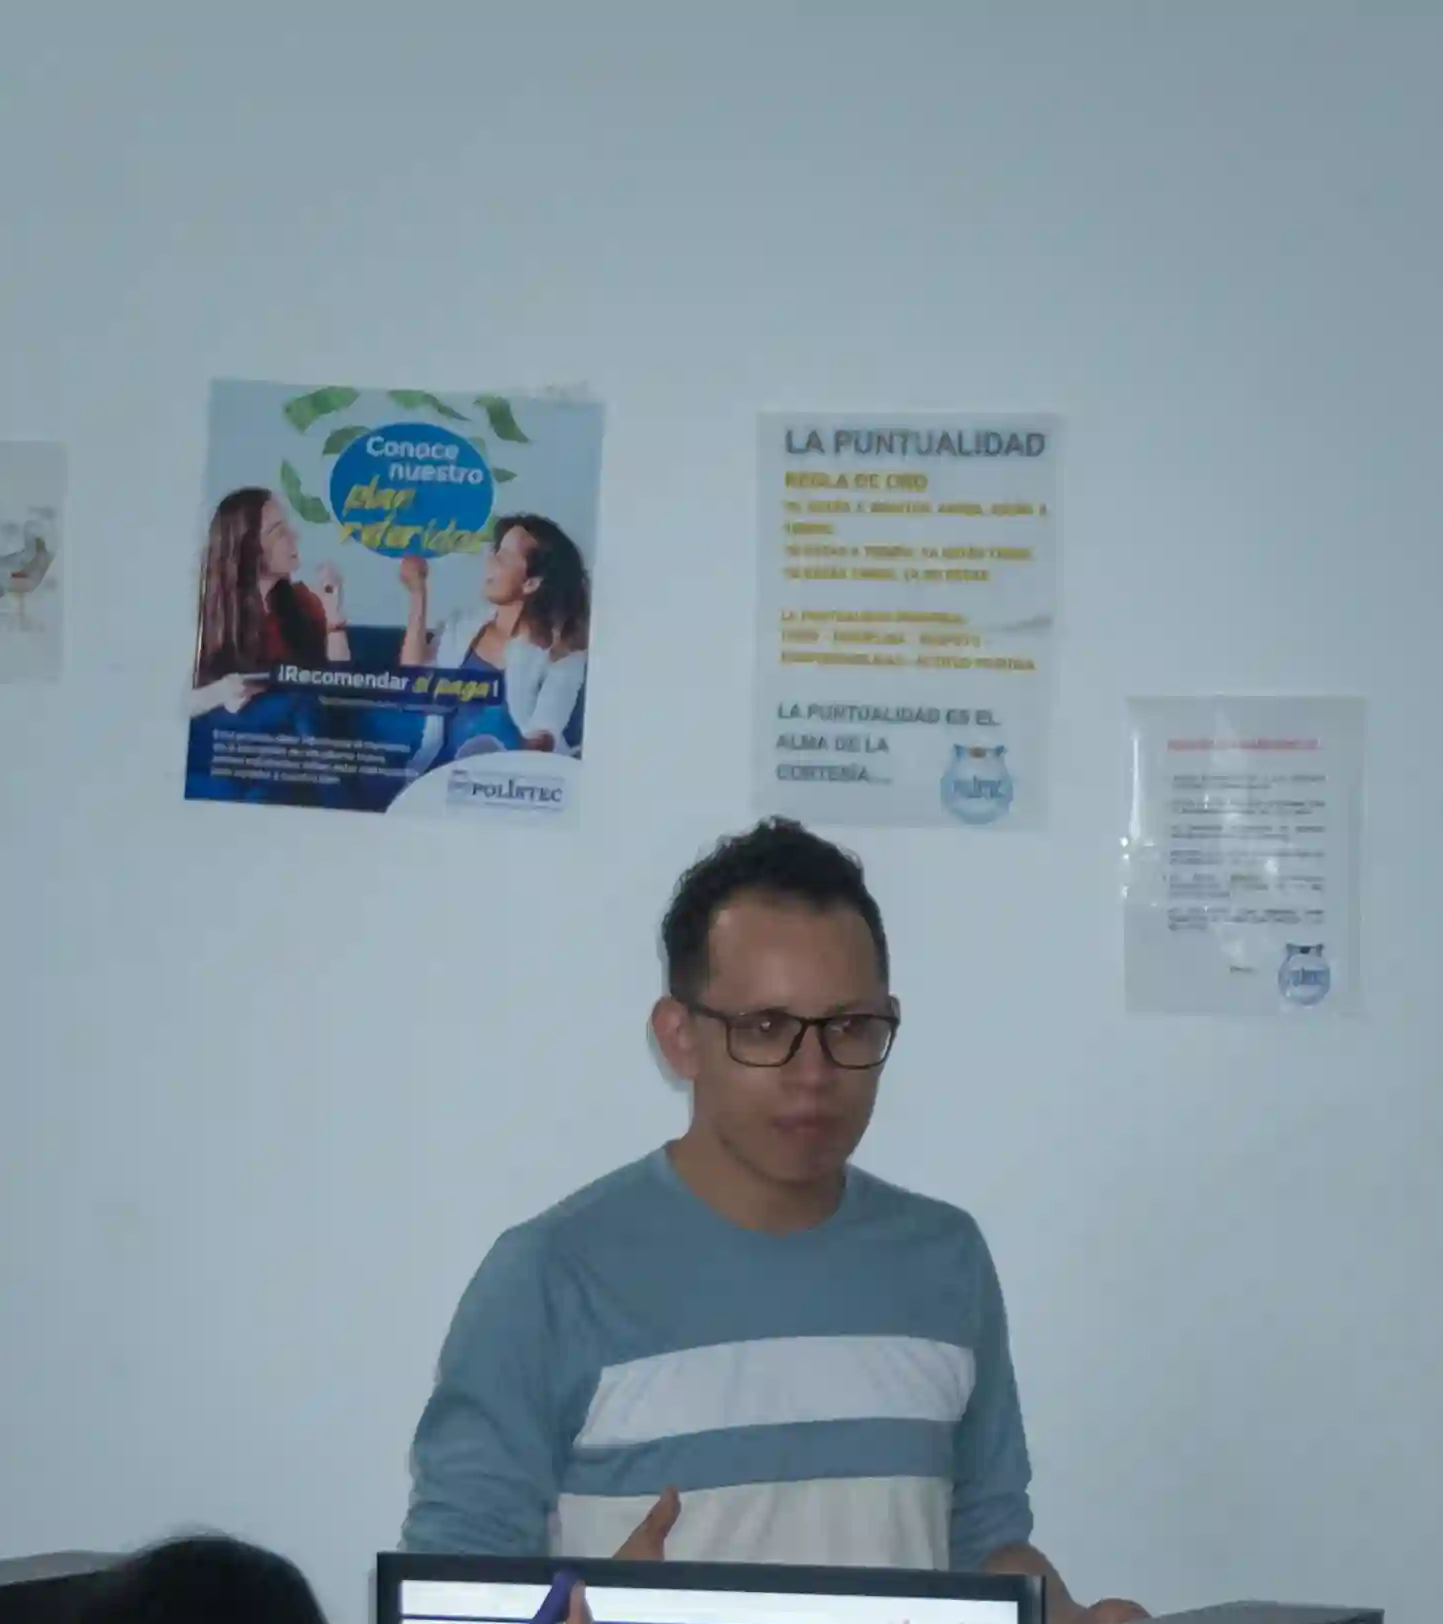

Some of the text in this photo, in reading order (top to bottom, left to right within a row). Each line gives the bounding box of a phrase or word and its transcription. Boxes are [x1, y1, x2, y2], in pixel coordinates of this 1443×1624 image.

[366, 435, 460, 461] Conoce
[784, 429, 1047, 457] LA PUNTUALIDAD
[388, 461, 485, 485] nuestro
[777, 702, 802, 719] LA
[807, 704, 941, 724] PUNTUALIDAD
[776, 734, 890, 753] ALMA DE LA
